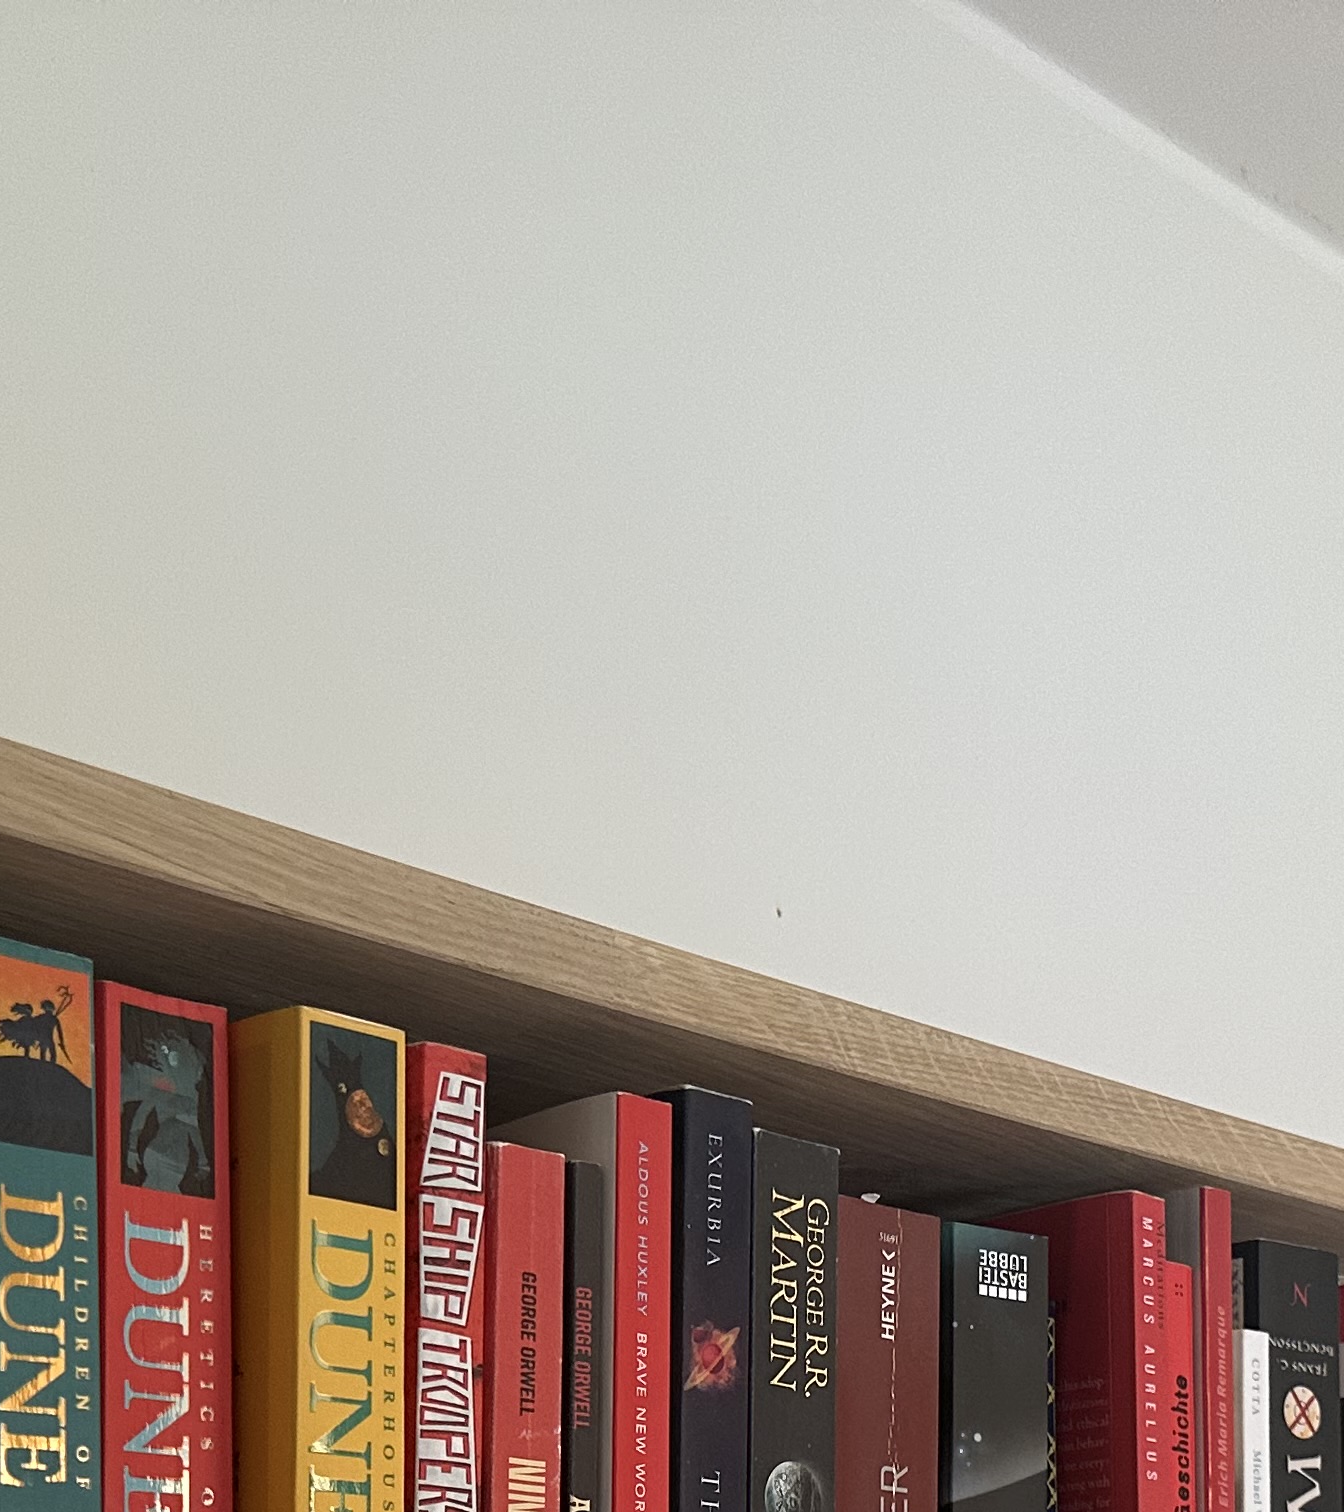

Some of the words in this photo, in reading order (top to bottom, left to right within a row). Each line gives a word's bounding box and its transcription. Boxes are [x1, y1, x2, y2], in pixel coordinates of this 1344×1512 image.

[422, 1074, 484, 1189] STAR
[637, 1140, 649, 1226] ALDOUS
[706, 1133, 723, 1266] EXURBIA
[421, 1198, 482, 1322] SHIP
[636, 1235, 649, 1317] HUXLEY
[769, 1187, 806, 1392] MARTIN
[806, 1198, 830, 1326] GEORGE
[978, 1248, 1028, 1273] LÜBBE
[978, 1266, 1028, 1290] BASTEI
[1141, 1215, 1155, 1326] MARCUS
[72, 1196, 90, 1411] CHILDREN
[199, 1224, 215, 1452] HERETICS
[520, 1271, 537, 1343] GEORGE
[575, 1286, 593, 1358] GEORGE
[881, 1263, 896, 1341] HEYNE
[519, 1347, 536, 1417] ORWELL
[635, 1332, 647, 1398] BRAVE
[1215, 1305, 1228, 1398] Remarque
[1251, 1357, 1260, 1415] COTTA
[572, 1360, 593, 1430] ORWELL
[635, 1407, 647, 1455] NEW
[1143, 1344, 1158, 1482] AURELIUS
[1216, 1404, 1228, 1458] Maria
[76, 1445, 91, 1490] OF
[1217, 1462, 1229, 1508] Erich
[1253, 1450, 1262, 1505] Michael
